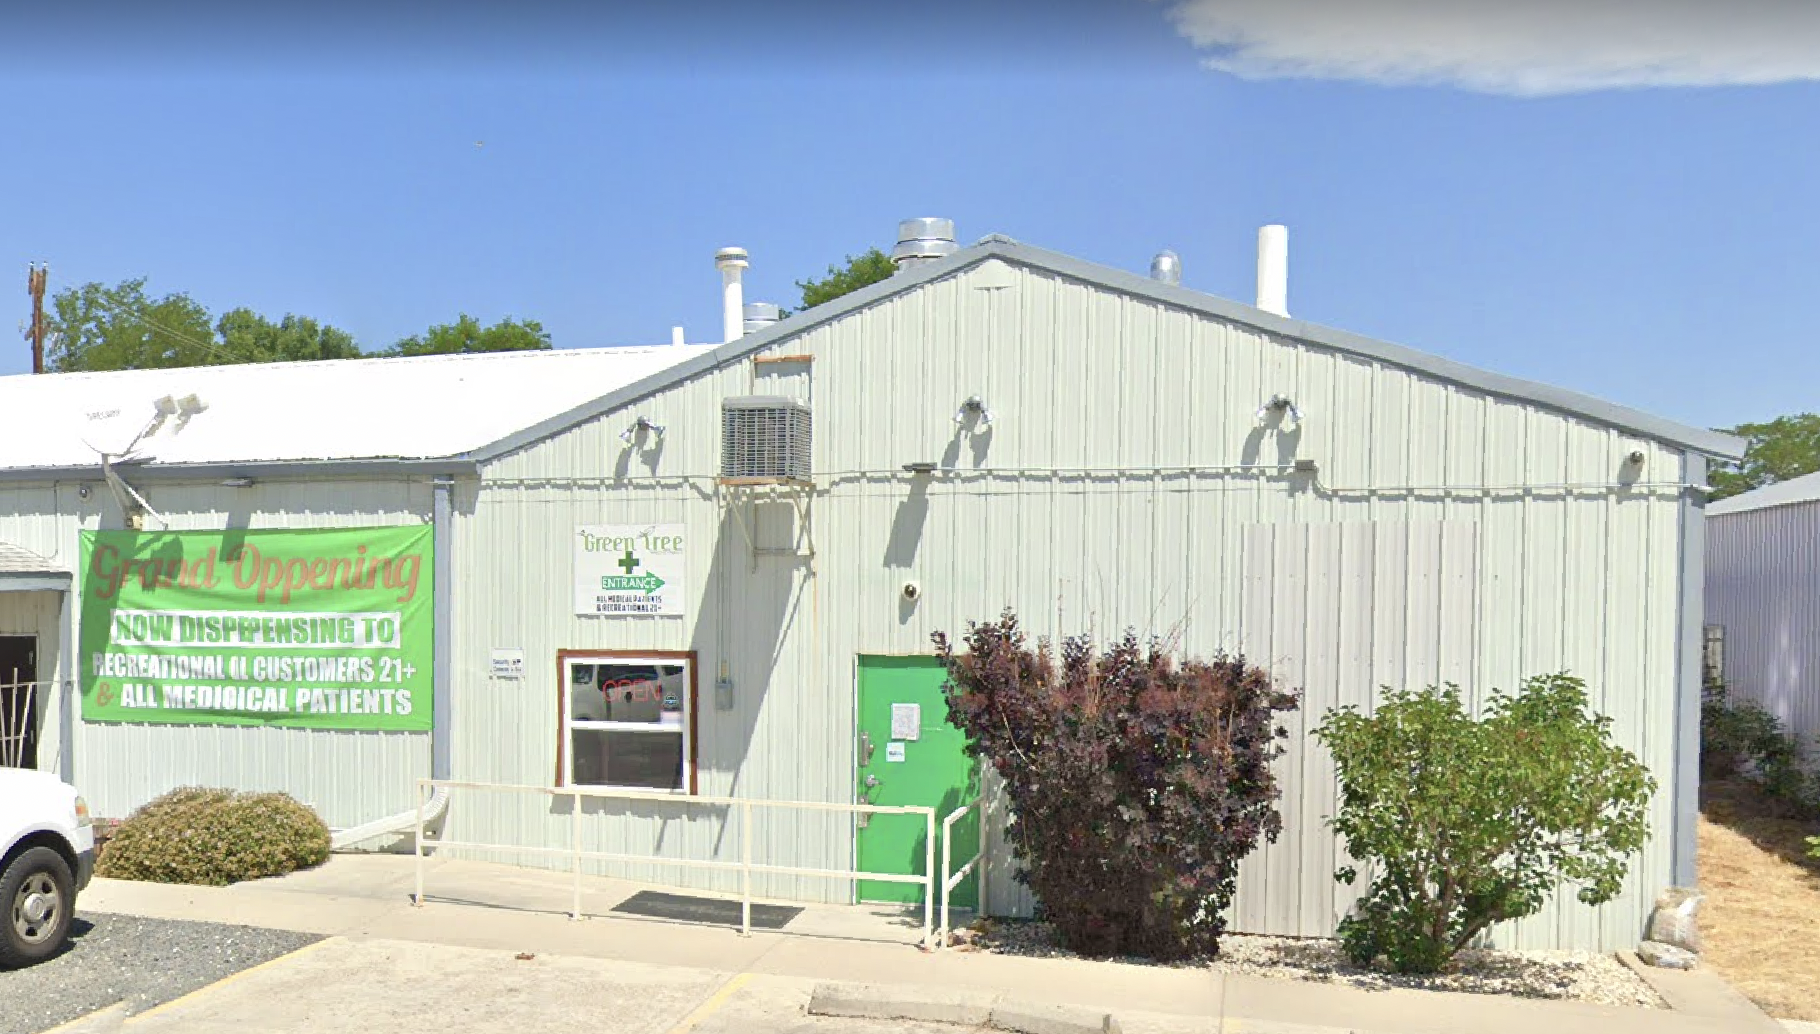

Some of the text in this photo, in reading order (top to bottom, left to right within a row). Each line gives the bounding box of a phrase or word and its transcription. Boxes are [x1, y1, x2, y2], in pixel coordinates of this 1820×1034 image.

[577, 525, 683, 554] Green Tree
[93, 544, 221, 598] Grand
[602, 577, 656, 589] ENTRANCE
[116, 615, 173, 641] NOW
[361, 618, 395, 643] TO
[93, 652, 225, 679] RECREATIONAL
[253, 656, 374, 682] CUSTOMERS
[379, 656, 417, 683] 21+
[121, 683, 157, 707] ALL
[295, 687, 412, 715] PATIENTS
[602, 679, 662, 703] OPEN
